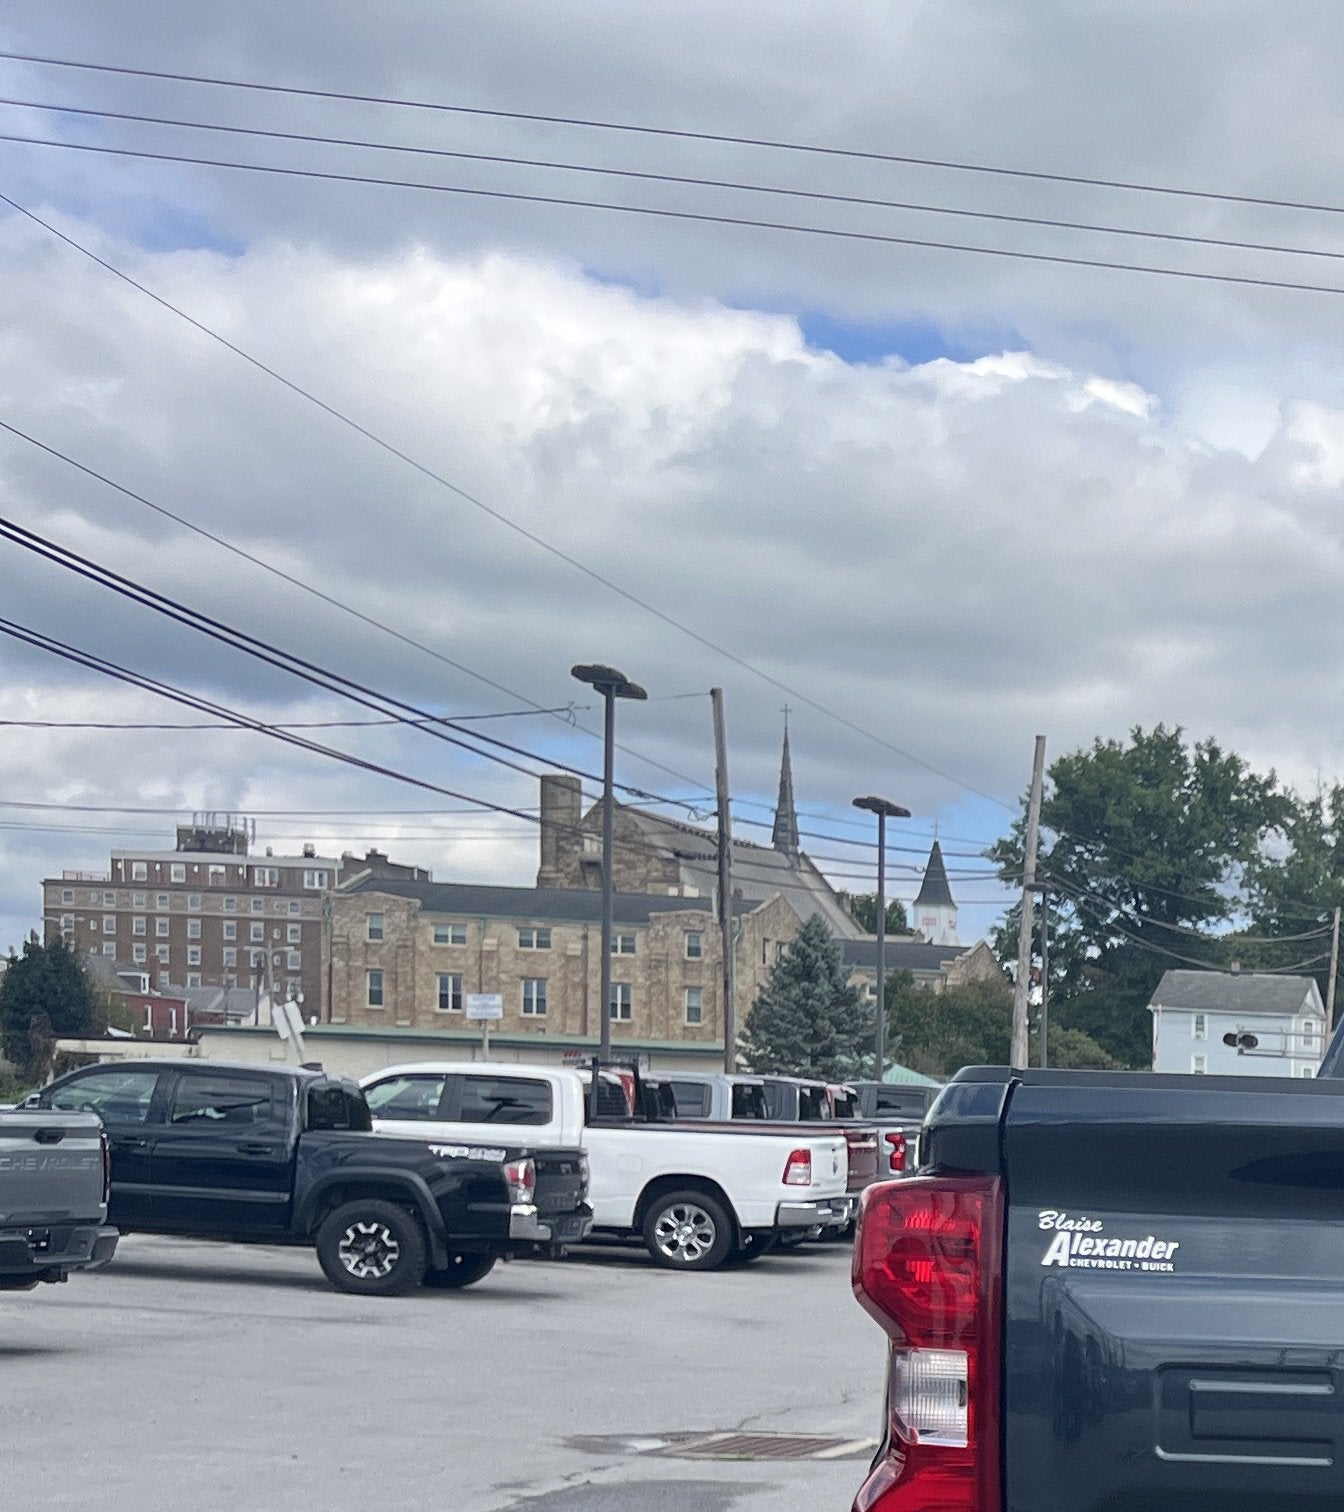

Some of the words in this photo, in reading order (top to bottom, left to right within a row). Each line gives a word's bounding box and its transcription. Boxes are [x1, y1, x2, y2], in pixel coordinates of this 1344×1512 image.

[1038, 1210, 1103, 1232] Blaise
[1041, 1231, 1179, 1267] Alexander
[1069, 1258, 1132, 1270] CHEVROLET
[1141, 1261, 1174, 1272] BUICK
